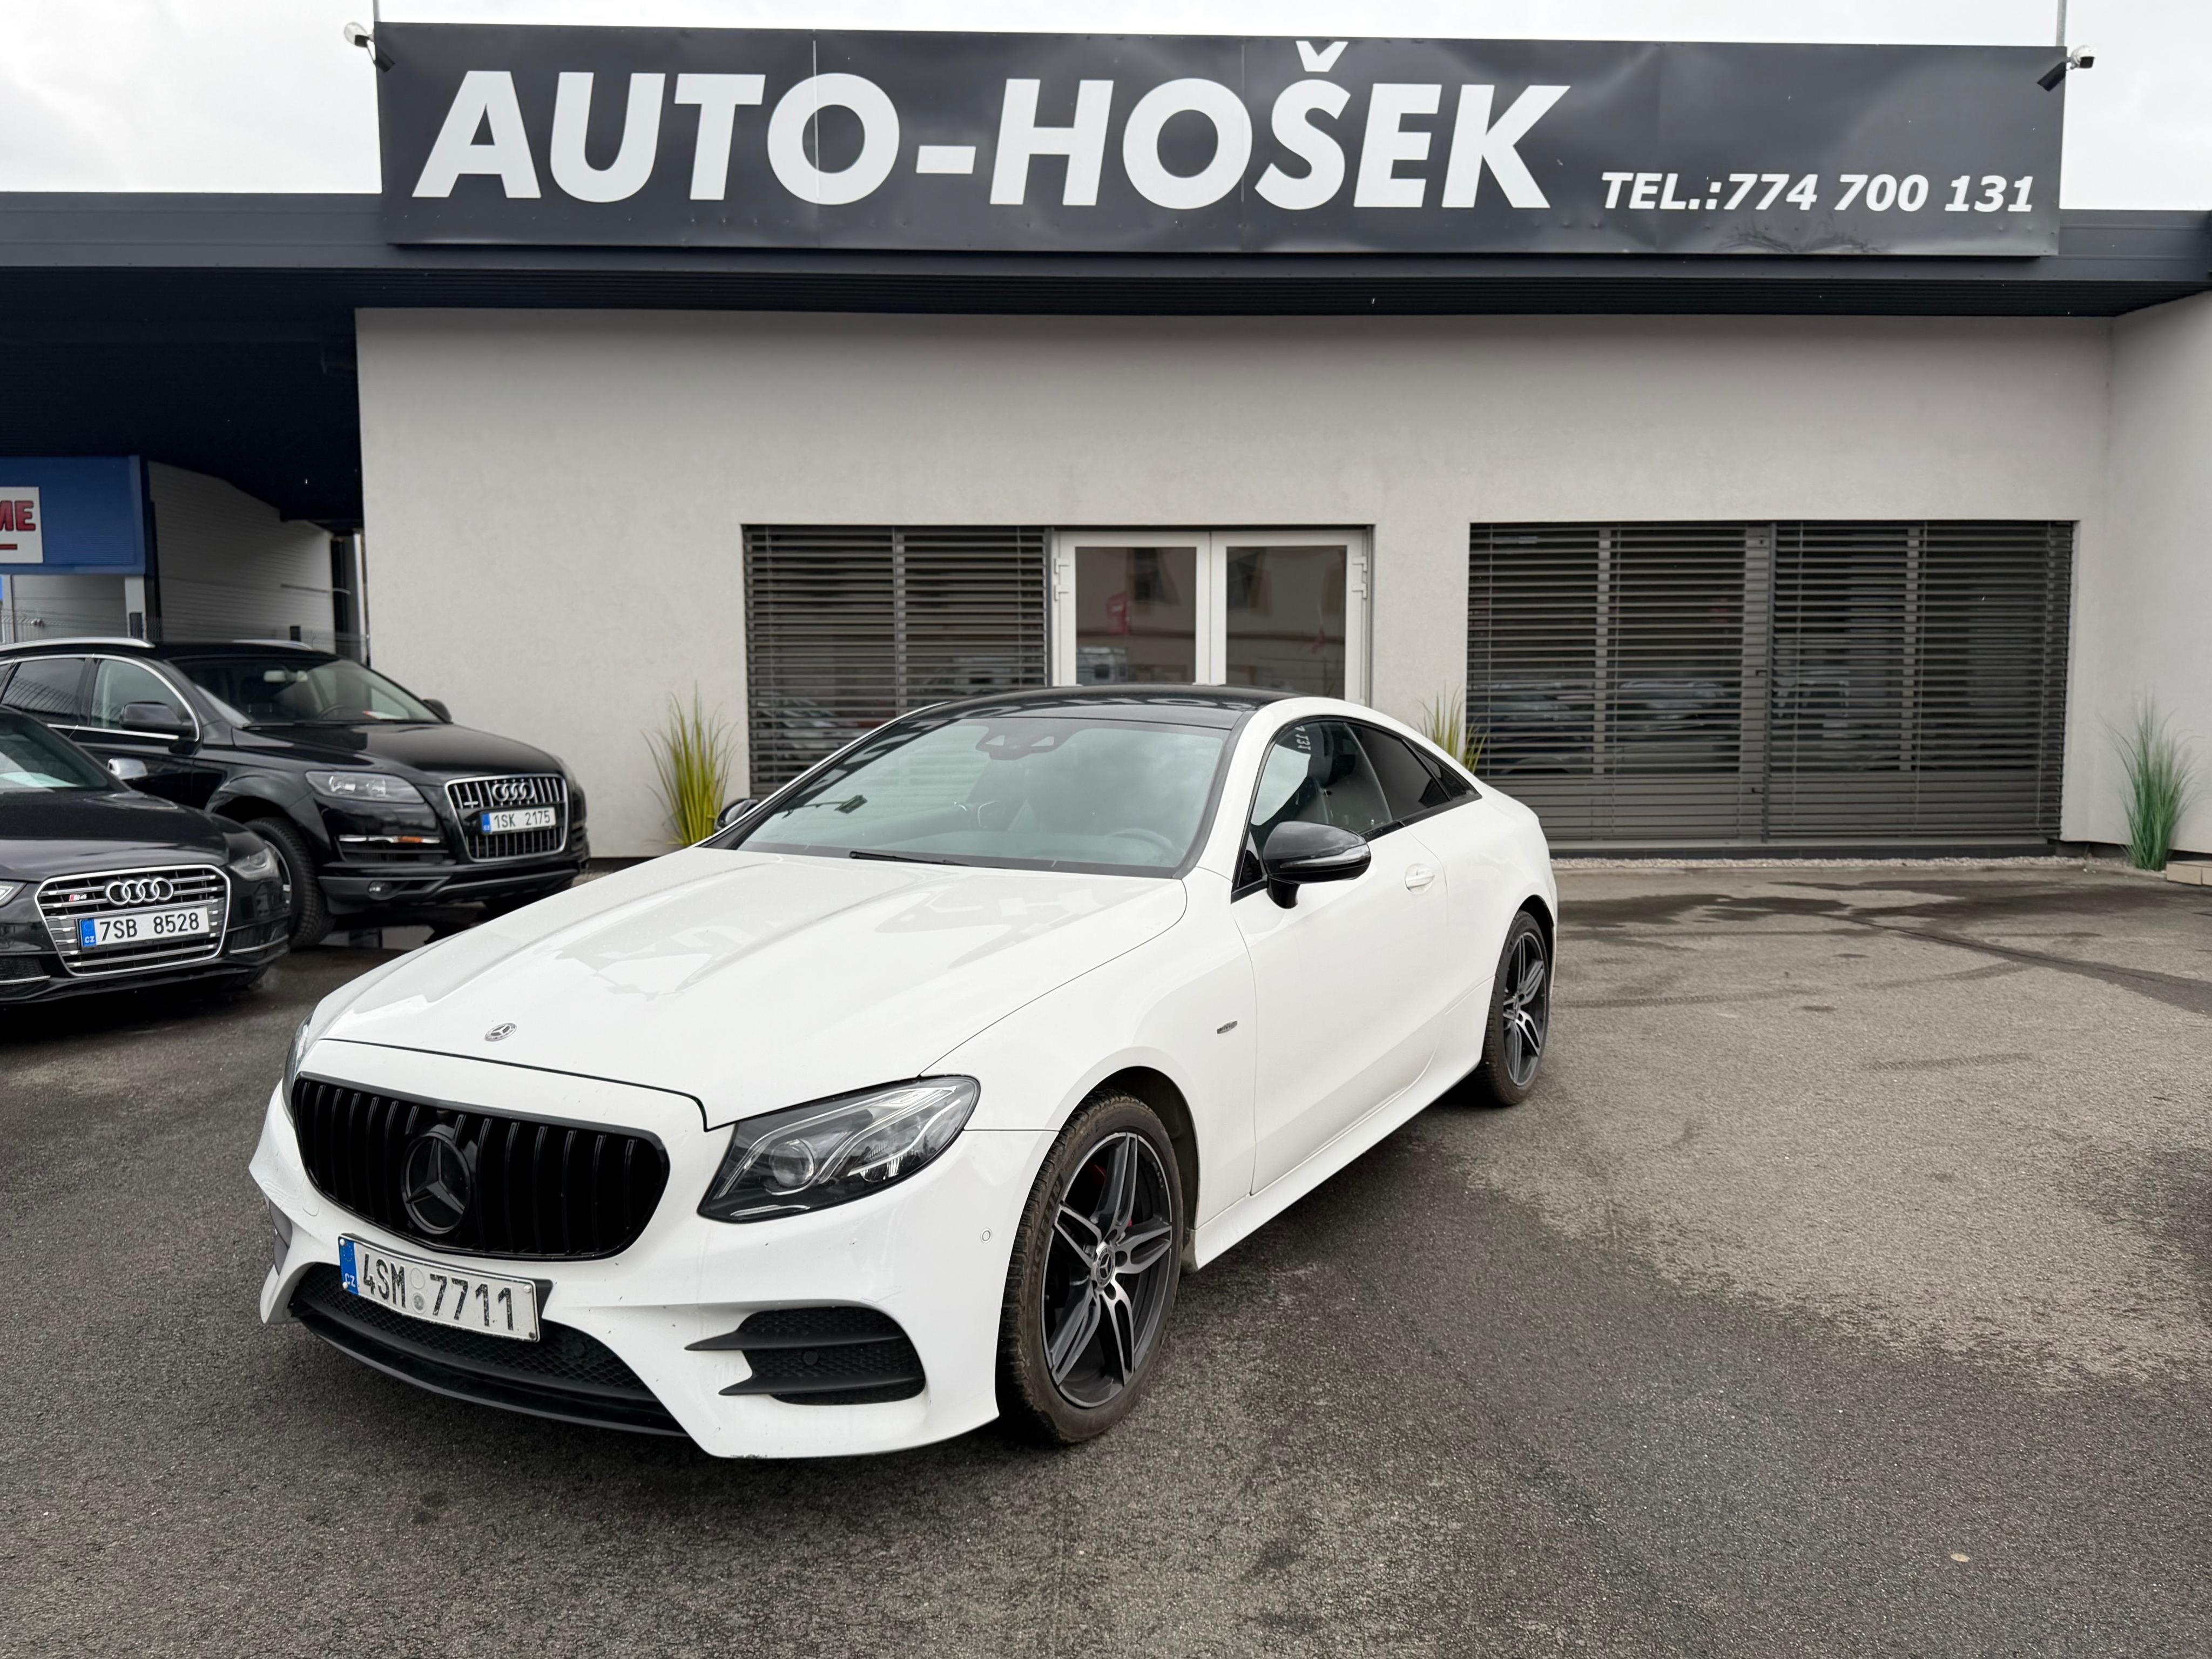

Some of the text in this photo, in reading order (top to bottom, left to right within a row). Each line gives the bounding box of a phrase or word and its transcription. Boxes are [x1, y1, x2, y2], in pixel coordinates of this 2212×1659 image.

[412, 41, 1570, 210] AUTO-HOŠEK
[1834, 174, 1929, 212] 700
[1944, 175, 2034, 213] 131
[494, 810, 551, 829] 1SK 2175
[85, 935, 95, 944] CZ
[99, 912, 200, 941] 7SB 8528
[344, 1273, 356, 1287] CZ
[362, 1253, 514, 1331] 4SM 7711
